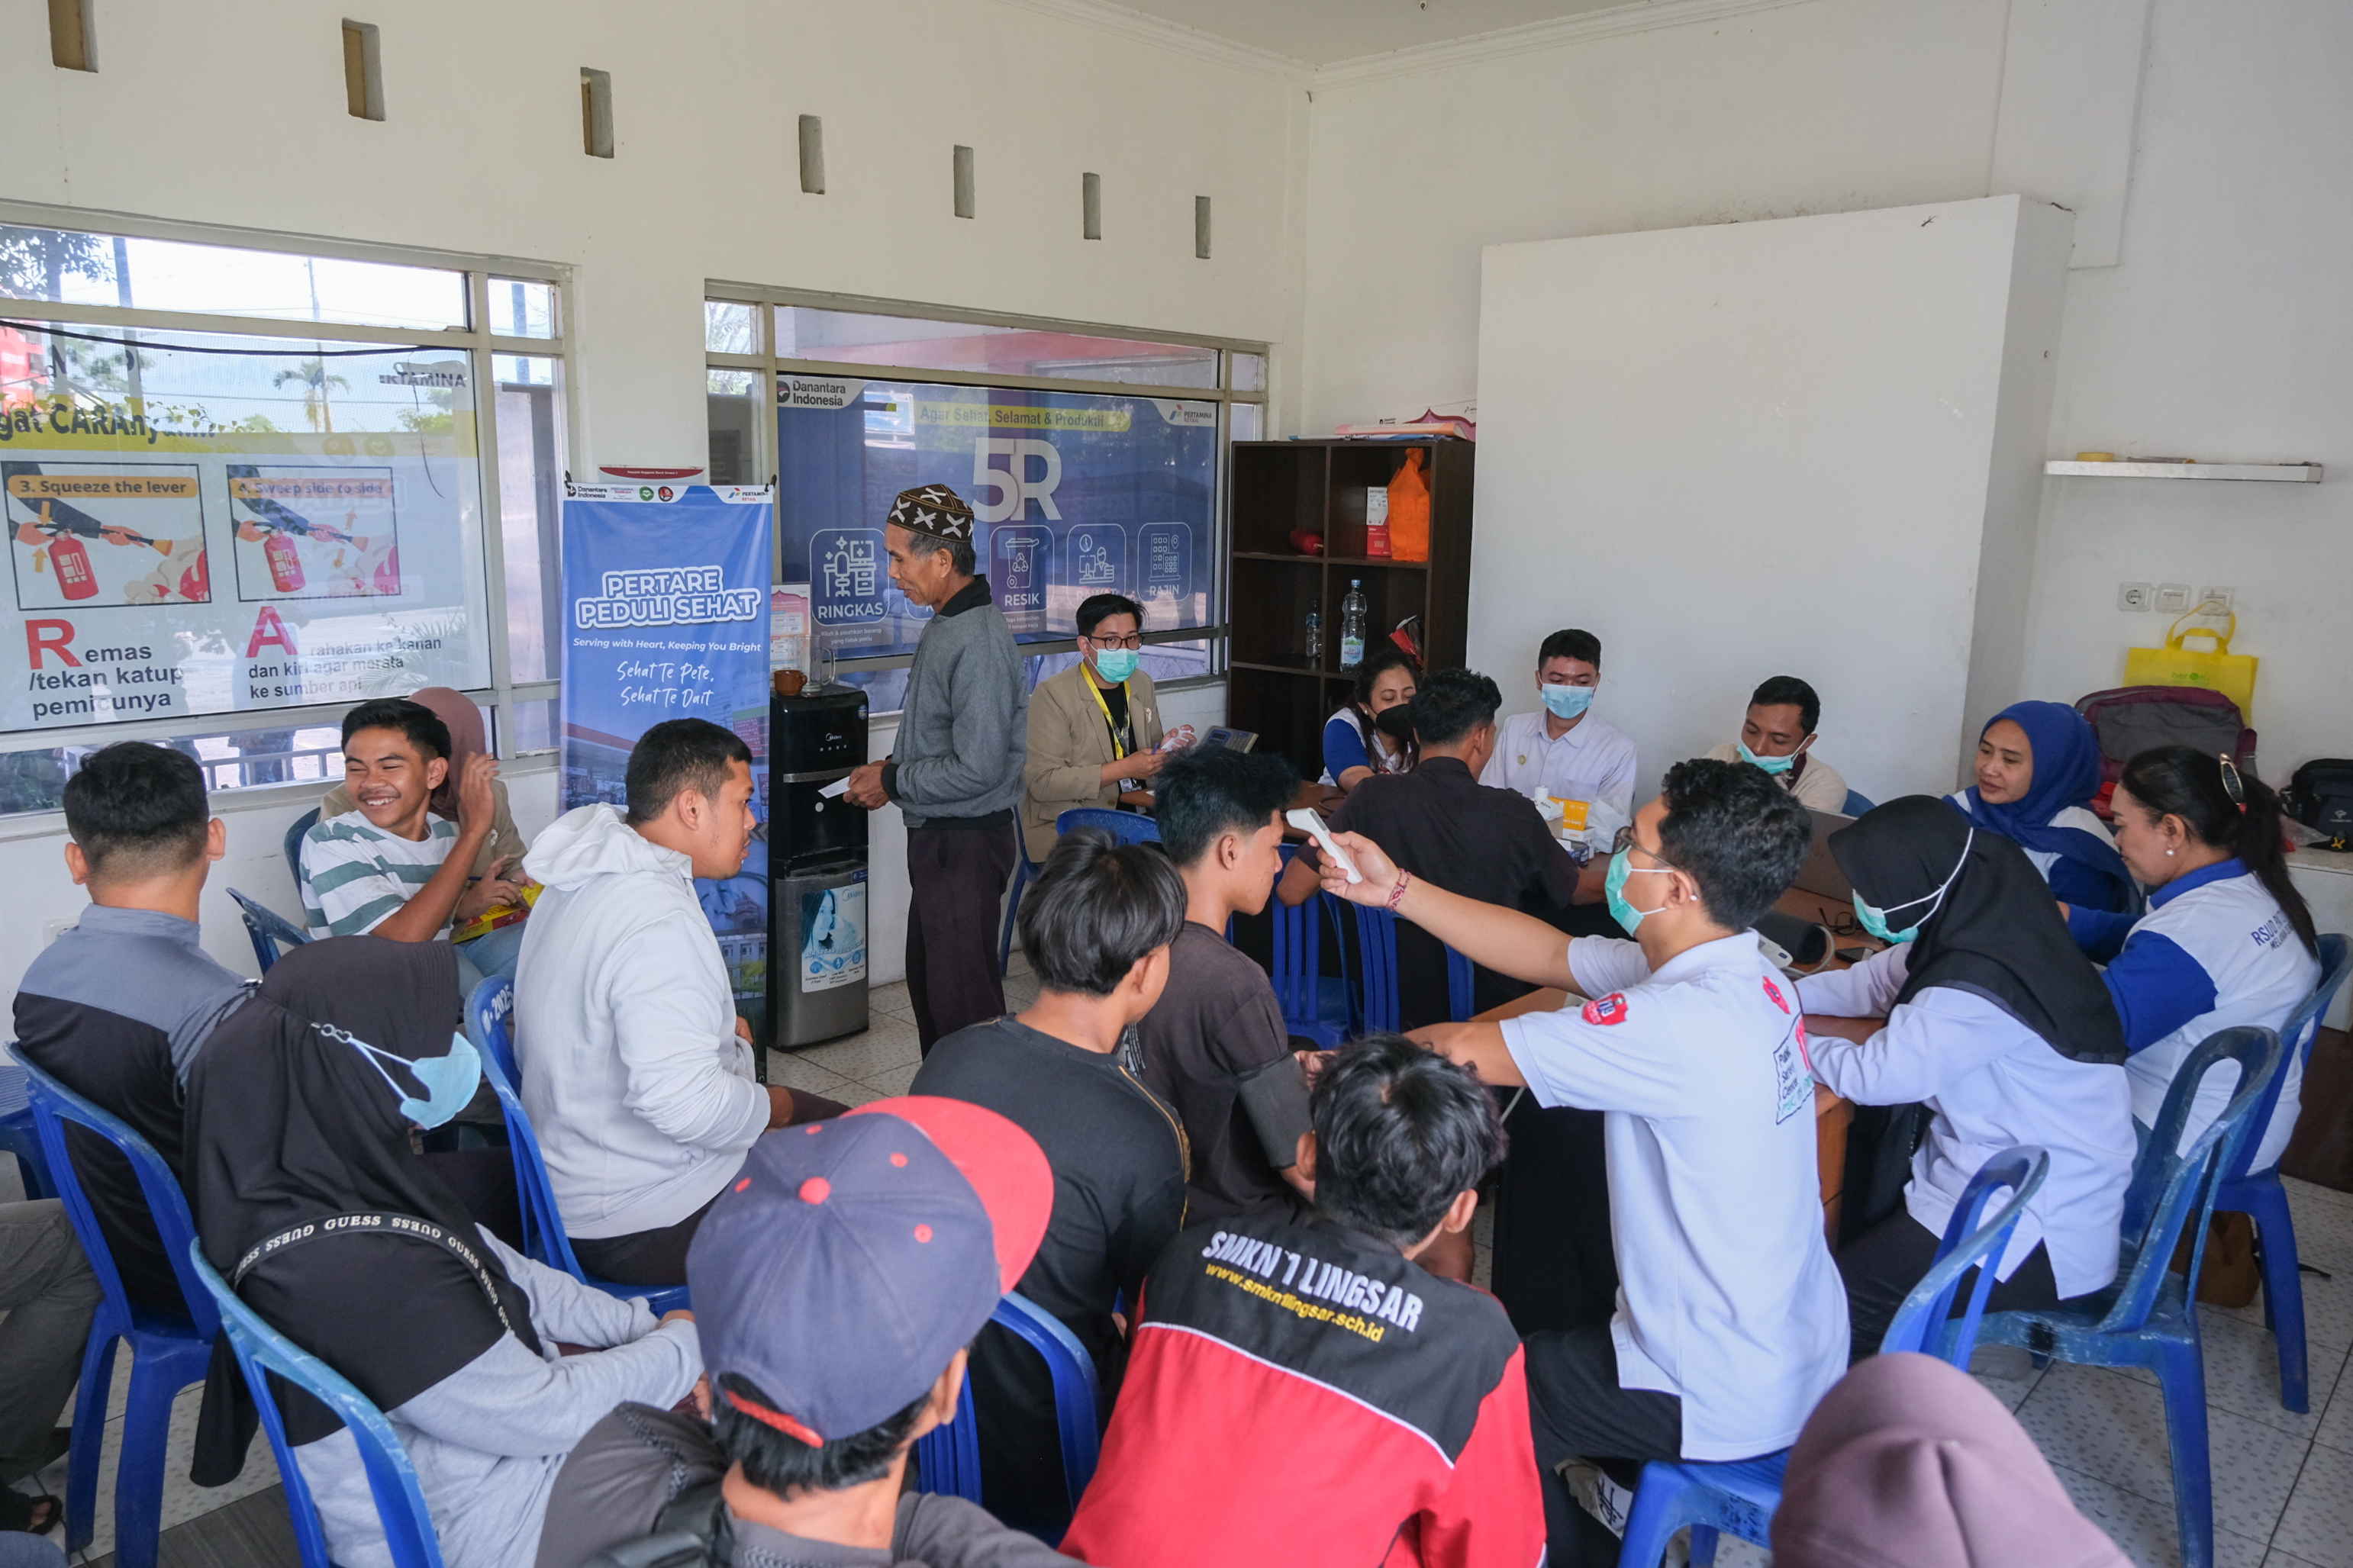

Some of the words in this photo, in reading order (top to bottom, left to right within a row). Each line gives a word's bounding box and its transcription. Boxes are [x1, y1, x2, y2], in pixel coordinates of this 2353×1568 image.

[793, 380, 846, 394] Danantara
[793, 394, 843, 406] Indonesia
[920, 407, 950, 423] Agar
[955, 407, 991, 424] Sehat,
[995, 410, 1041, 425] Selamat
[1044, 413, 1052, 425] &
[1056, 414, 1104, 427] Produktif
[20, 481, 35, 492] 3.
[40, 481, 111, 495] Squeeze
[116, 481, 142, 493] the
[147, 481, 186, 493] lever
[972, 437, 1062, 523] 5R
[238, 483, 250, 494] 4.
[256, 483, 301, 497] Sweep
[305, 483, 333, 494] side
[338, 484, 351, 494] to
[356, 483, 382, 494] side
[608, 571, 720, 596] PERTARE
[1149, 584, 1180, 597] RAJIN
[582, 600, 670, 622] PEDULI
[675, 594, 755, 618] SEHAT
[1004, 592, 1040, 607] RESIK
[818, 602, 883, 619] RINGKAS
[840, 629, 863, 638] pisahkan
[398, 638, 441, 651] kanan
[573, 638, 610, 649] Serving
[612, 639, 633, 648] with
[637, 639, 666, 650] Heart,
[668, 641, 706, 652] Keeping
[708, 642, 726, 651] You
[730, 642, 761, 652] Bright
[117, 666, 184, 685] katup
[249, 665, 279, 678] dan
[284, 662, 308, 676] kiri
[314, 660, 347, 676] agar
[353, 655, 404, 671] merata
[617, 661, 657, 681] Sehat
[659, 662, 675, 683] Te
[250, 685, 269, 699] ke
[275, 679, 334, 696] sumber
[340, 677, 361, 693] api
[620, 686, 661, 706] Sehat
[662, 687, 678, 708] Te
[33, 692, 171, 721] pemicunya
[842, 889, 864, 902] Midea
[2251, 919, 2278, 946] RSUD
[266, 1224, 314, 1252] GUESS
[324, 1215, 382, 1232] GUESS
[392, 1217, 441, 1238] GUESS
[448, 1235, 479, 1269] GUESS
[481, 1268, 498, 1305] GUESS
[1201, 1231, 1283, 1278] SMKN
[1281, 1250, 1301, 1286] 1
[1298, 1257, 1423, 1332] LINGSAR
